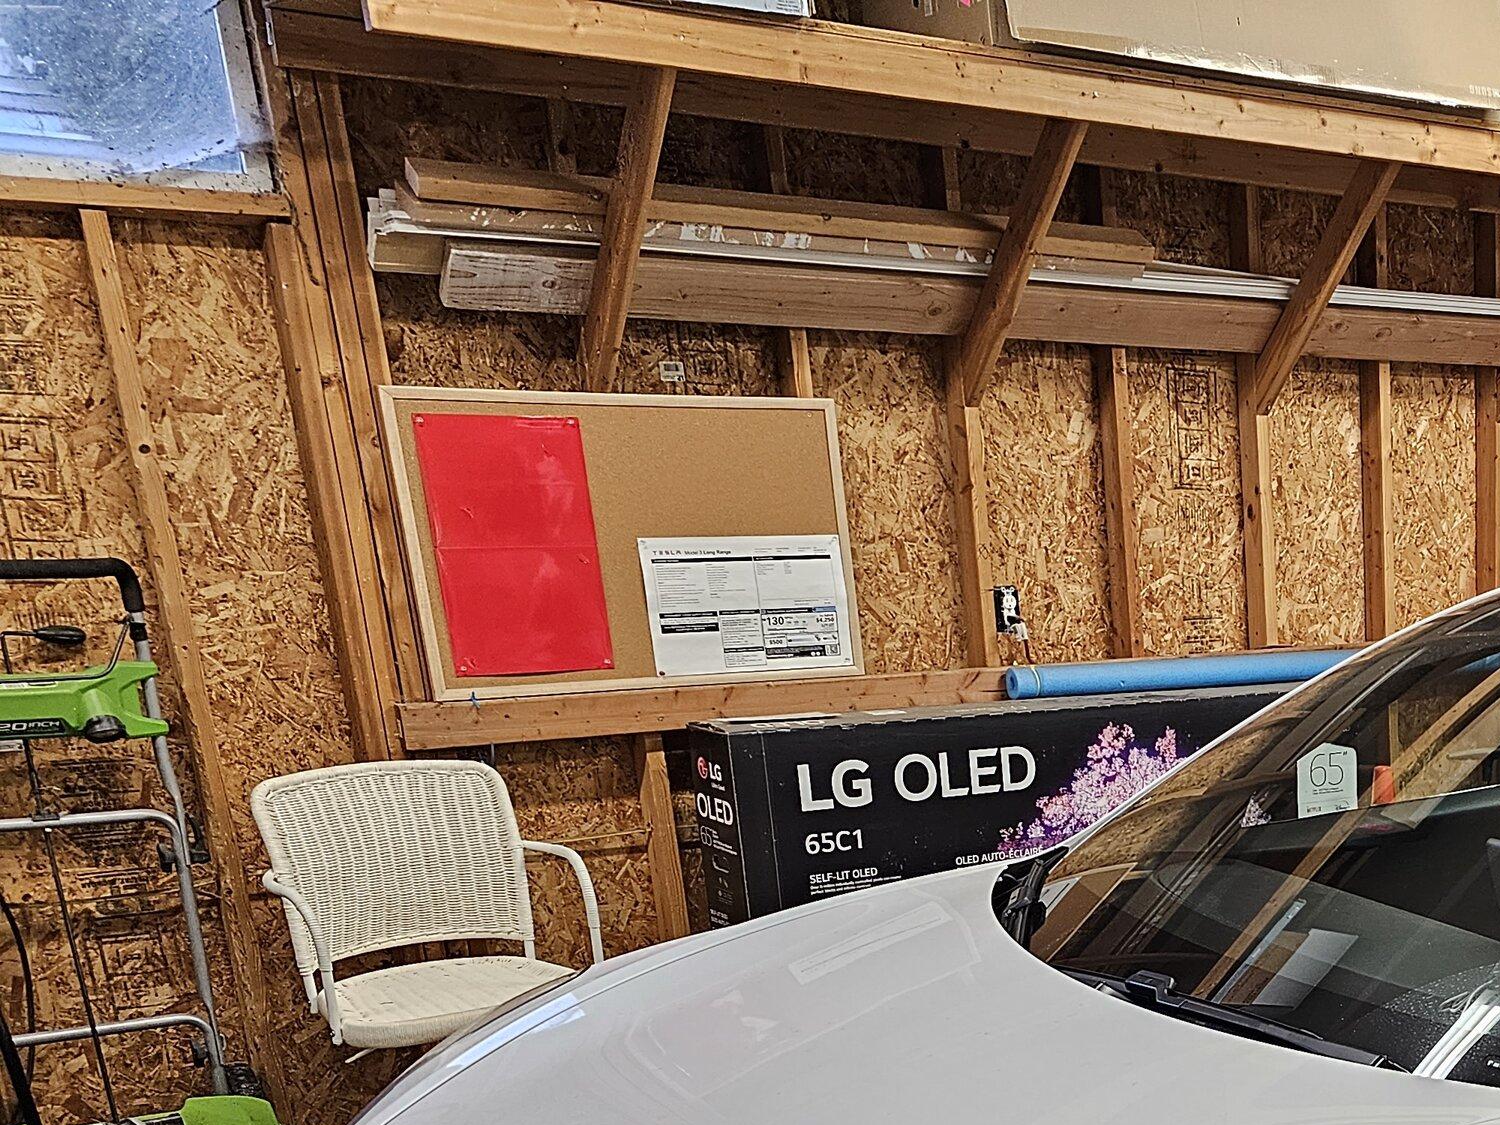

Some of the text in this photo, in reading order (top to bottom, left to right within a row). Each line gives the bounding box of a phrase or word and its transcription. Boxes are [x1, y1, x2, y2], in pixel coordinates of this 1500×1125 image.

[766, 616, 785, 626] 130
[709, 762, 722, 781] LG
[796, 746, 1036, 812] LG OLED
[697, 792, 733, 826] OLED
[805, 829, 863, 855] 65C1
[955, 854, 979, 866] OLED
[809, 870, 851, 884] SELF-LIT
[852, 867, 878, 879] OLED
